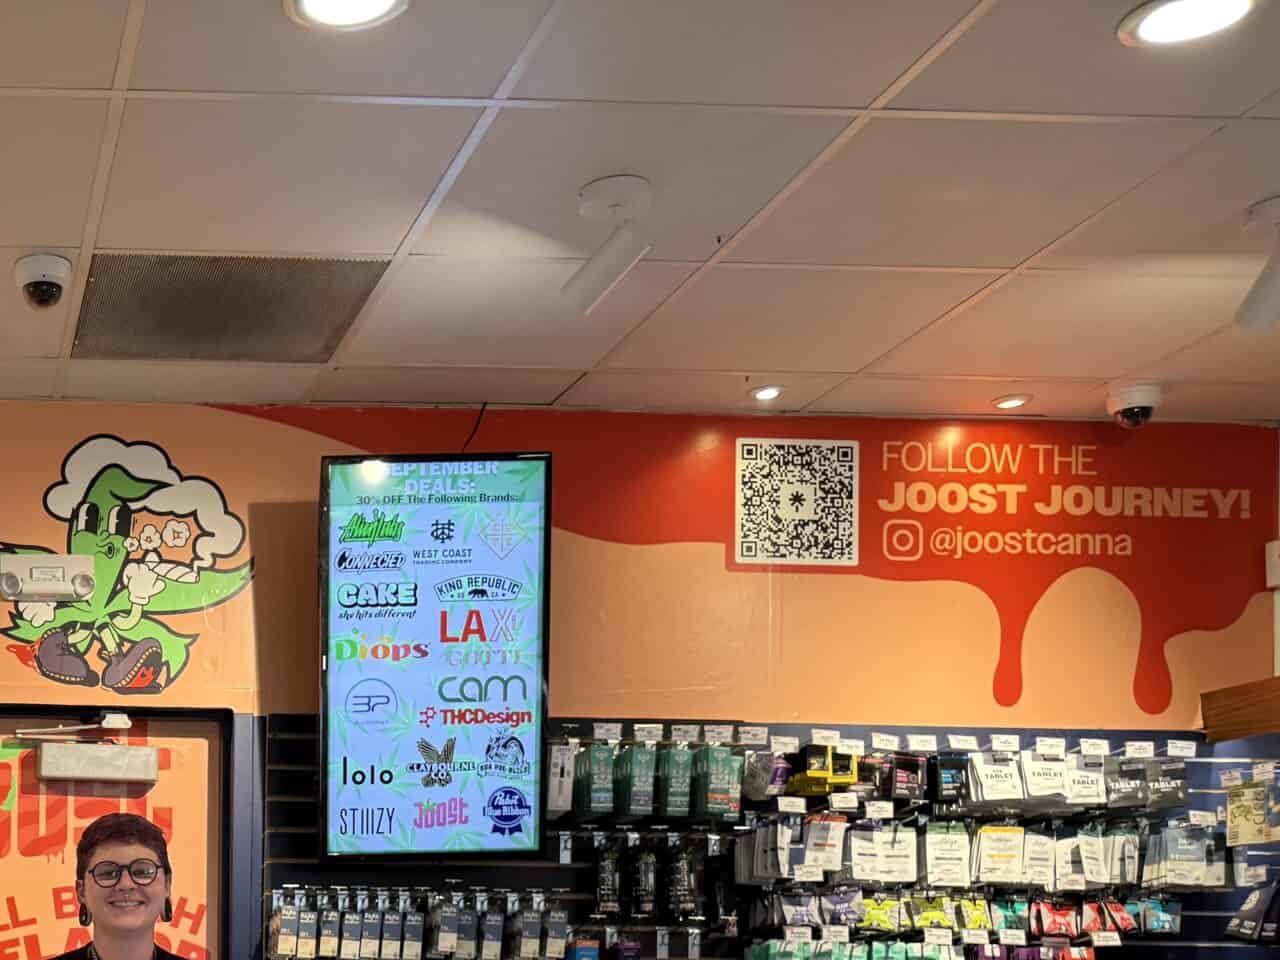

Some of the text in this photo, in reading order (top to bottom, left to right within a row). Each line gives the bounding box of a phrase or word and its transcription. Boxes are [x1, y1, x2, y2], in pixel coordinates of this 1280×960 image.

[881, 441, 1098, 476] FOLLOW THE
[405, 479, 476, 494] DEALS:
[384, 494, 403, 504] OFF
[407, 494, 424, 504] The
[428, 494, 477, 506] Following
[878, 481, 1252, 519] JOOST JOURNEY!
[413, 549, 473, 559] WEST COAST
[929, 528, 1132, 557] @joostcanna
[337, 582, 418, 608] CAKE
[466, 576, 520, 594] REPUBLIC
[339, 608, 416, 621] she hits different
[440, 608, 515, 643] LAX
[438, 675, 527, 702] cam
[439, 707, 532, 727] THCDesign
[342, 756, 393, 785] lolo
